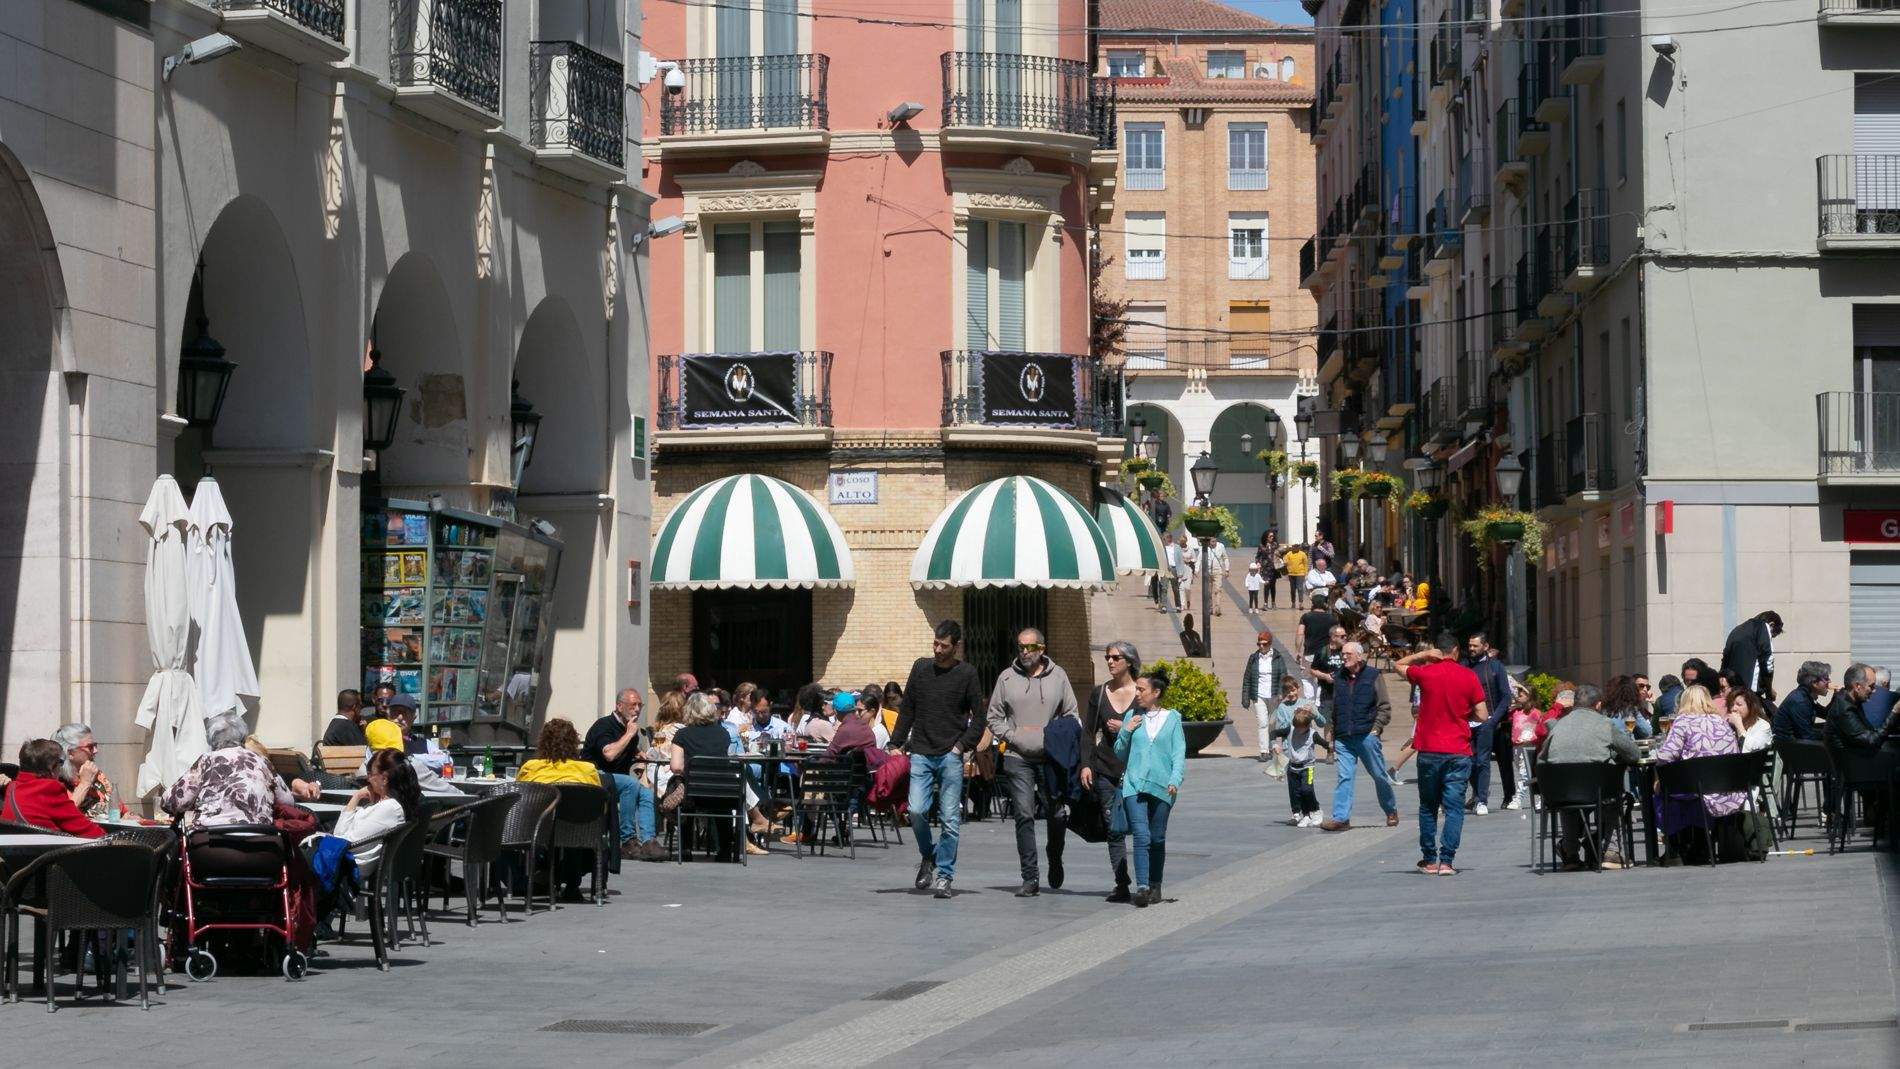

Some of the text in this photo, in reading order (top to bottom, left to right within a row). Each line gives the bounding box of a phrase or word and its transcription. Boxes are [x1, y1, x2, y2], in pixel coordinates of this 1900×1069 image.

[694, 409, 788, 418] SEMANA SANTA
[992, 409, 1069, 418] SEMANA SANTA
[1880, 519, 1900, 538] G
